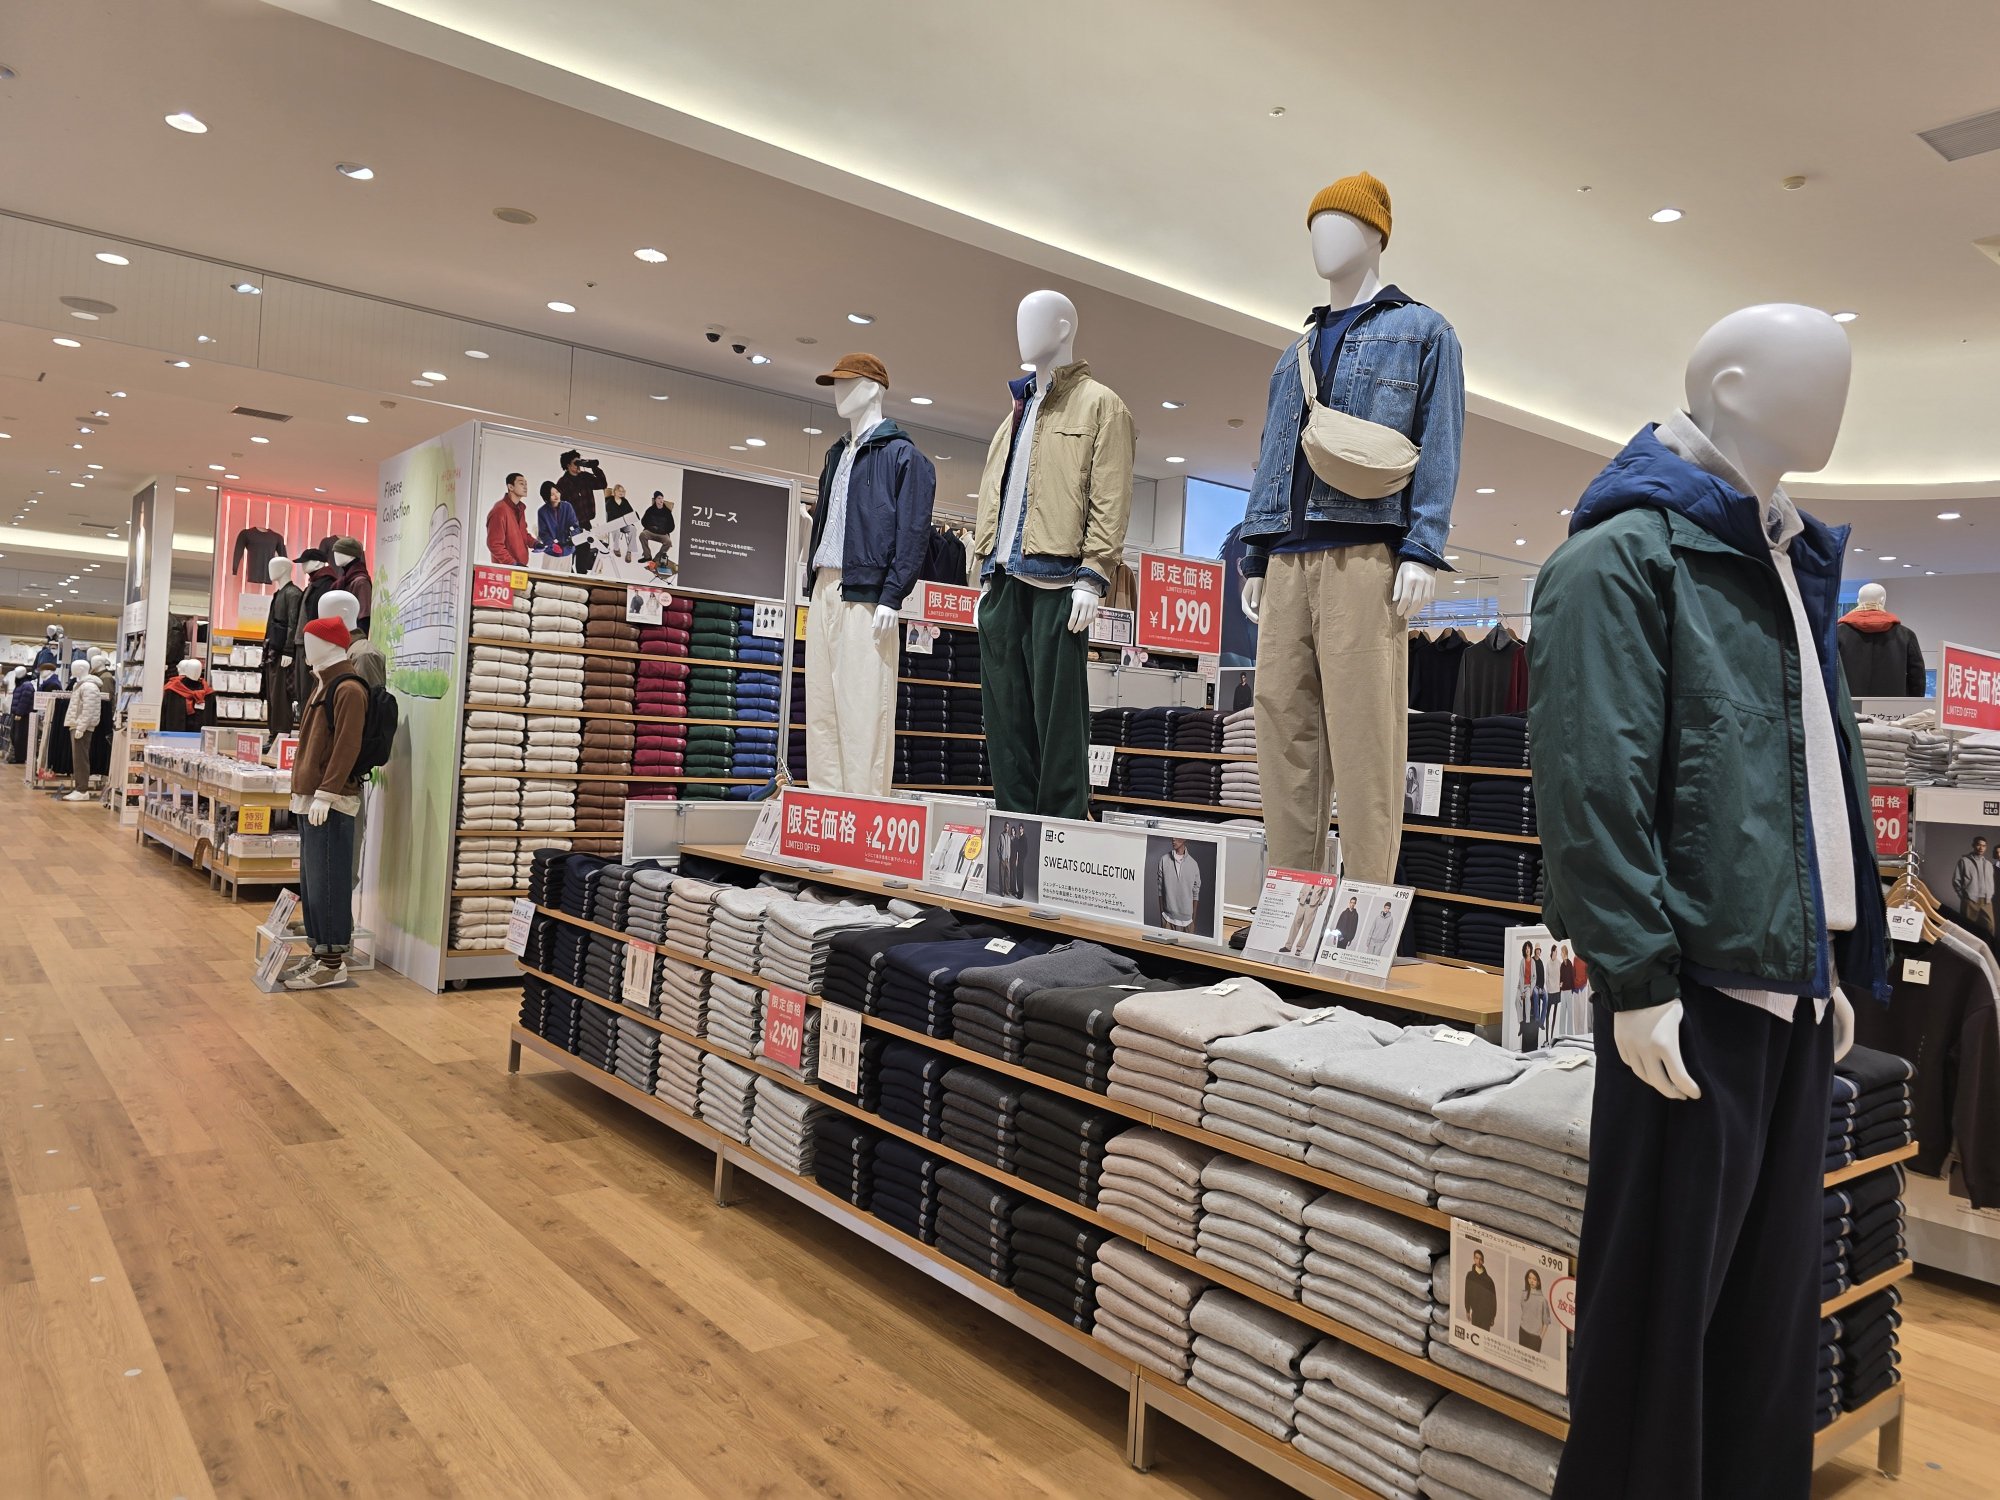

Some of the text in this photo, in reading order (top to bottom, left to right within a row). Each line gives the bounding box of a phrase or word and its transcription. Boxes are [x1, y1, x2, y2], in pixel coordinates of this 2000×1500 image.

[384, 481, 402, 498] Fleece
[382, 501, 410, 522] Collection
[692, 506, 738, 523] フリース
[692, 520, 710, 528] FLEECE
[1151, 561, 1213, 590] 限定価格
[1150, 595, 1211, 635] ¥1,990
[1946, 704, 1978, 718] LIMITED OFFER
[244, 822, 263, 830] 価格
[245, 812, 264, 821] 特別
[787, 804, 857, 844] 限定価格
[866, 815, 920, 854] ¥2,990
[785, 840, 804, 851] LIMITED
[804, 842, 821, 853] OFFER
[1044, 856, 1135, 881] SWEATS COLLECTION
[772, 995, 801, 1017] 限定価格
[769, 1020, 798, 1051] ¥2,990
